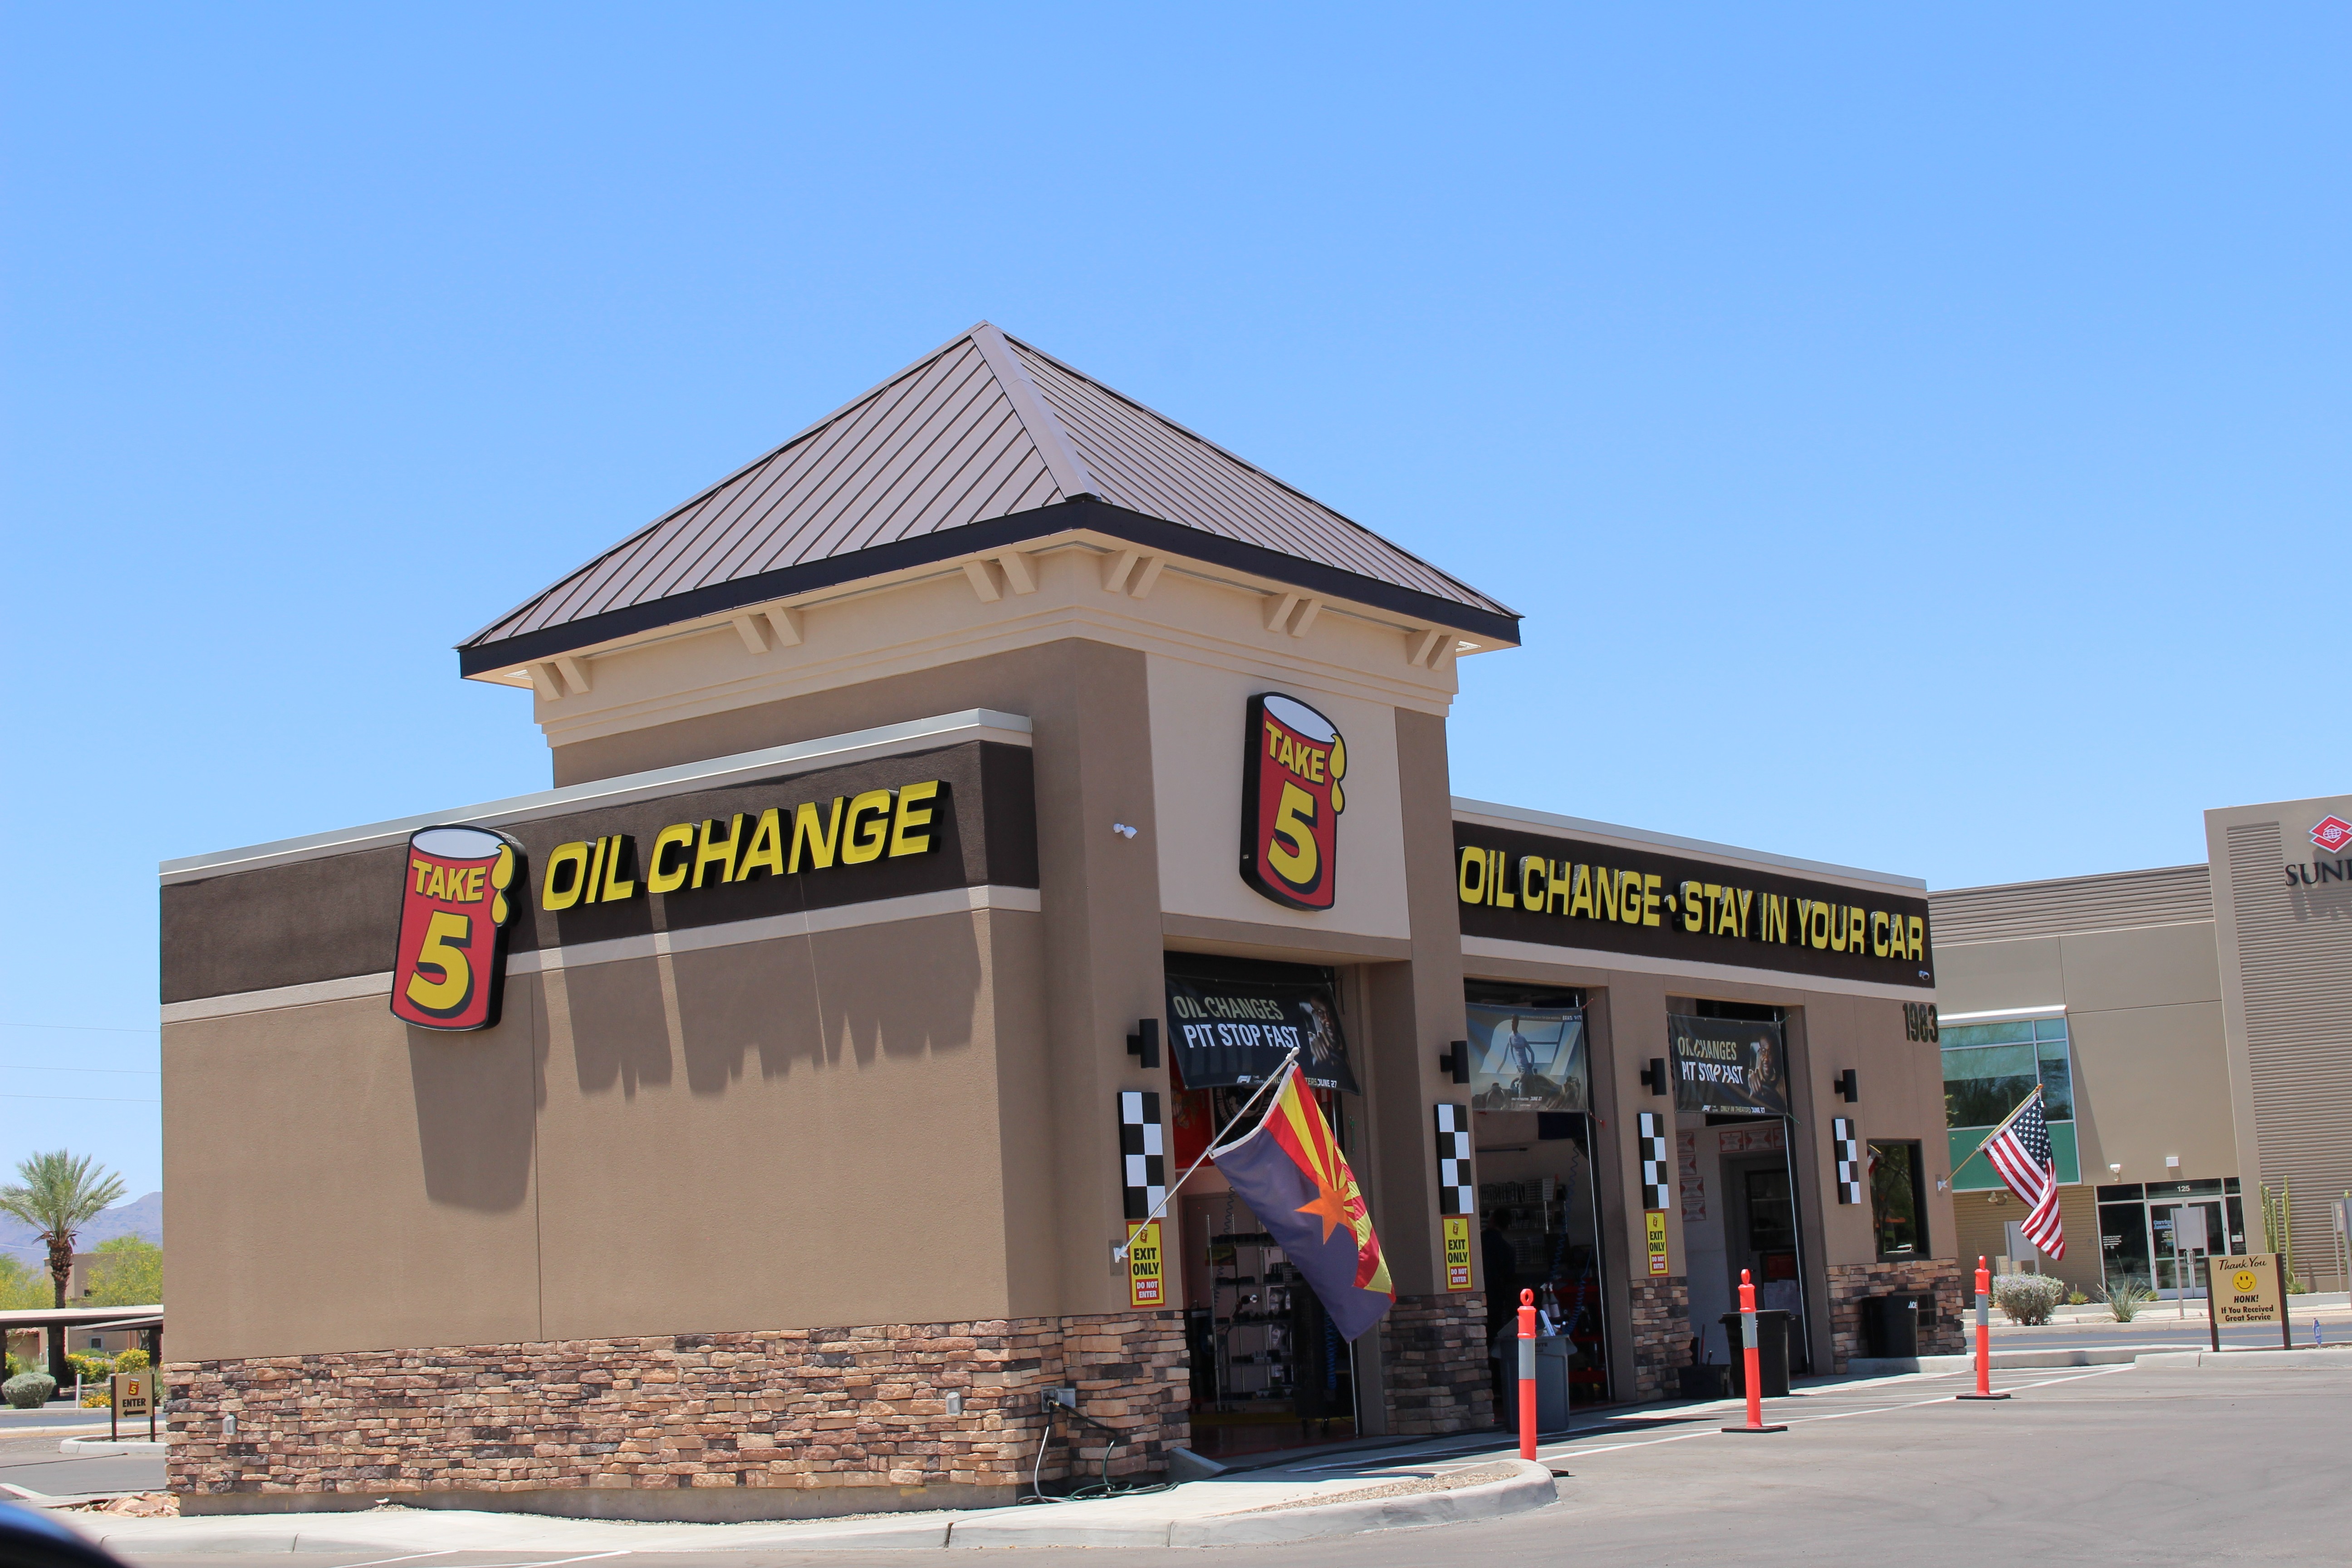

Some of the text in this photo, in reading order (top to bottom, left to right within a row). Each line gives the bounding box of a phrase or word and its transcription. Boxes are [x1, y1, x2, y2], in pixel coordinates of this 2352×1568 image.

[1265, 720, 1325, 784] TAKE
[1267, 780, 1317, 884] 5
[542, 780, 939, 911] OIL CHANGE
[412, 858, 487, 902] TAKE
[1459, 846, 1924, 961] OIL CHANGE STAY IN YOUR CAR
[406, 911, 470, 1010] 5
[1173, 996, 1284, 1020] OIL CHANGES
[1902, 1002, 1939, 1043] 1983
[1183, 1023, 1301, 1049] PIT STOP FAST
[1677, 1036, 1737, 1061] OIL CHANGES
[1681, 1061, 1743, 1084] PIT STOP FAST
[1317, 1078, 1330, 1087] JUNE
[1331, 1080, 1337, 1088] 27
[1650, 1231, 1663, 1240] EXIT
[1448, 1239, 1465, 1250] EXIT
[1649, 1242, 1665, 1252] ONLY
[1134, 1247, 1156, 1260] EXIT
[1447, 1252, 1468, 1263] ONLY
[1132, 1262, 1159, 1276] ONLY
[2219, 1256, 2267, 1270] Thank You
[2234, 1294, 2259, 1303] HONK!
[2243, 1304, 2274, 1313] Received
[129, 1385, 137, 1394] 5
[122, 1398, 146, 1407] ENTER
